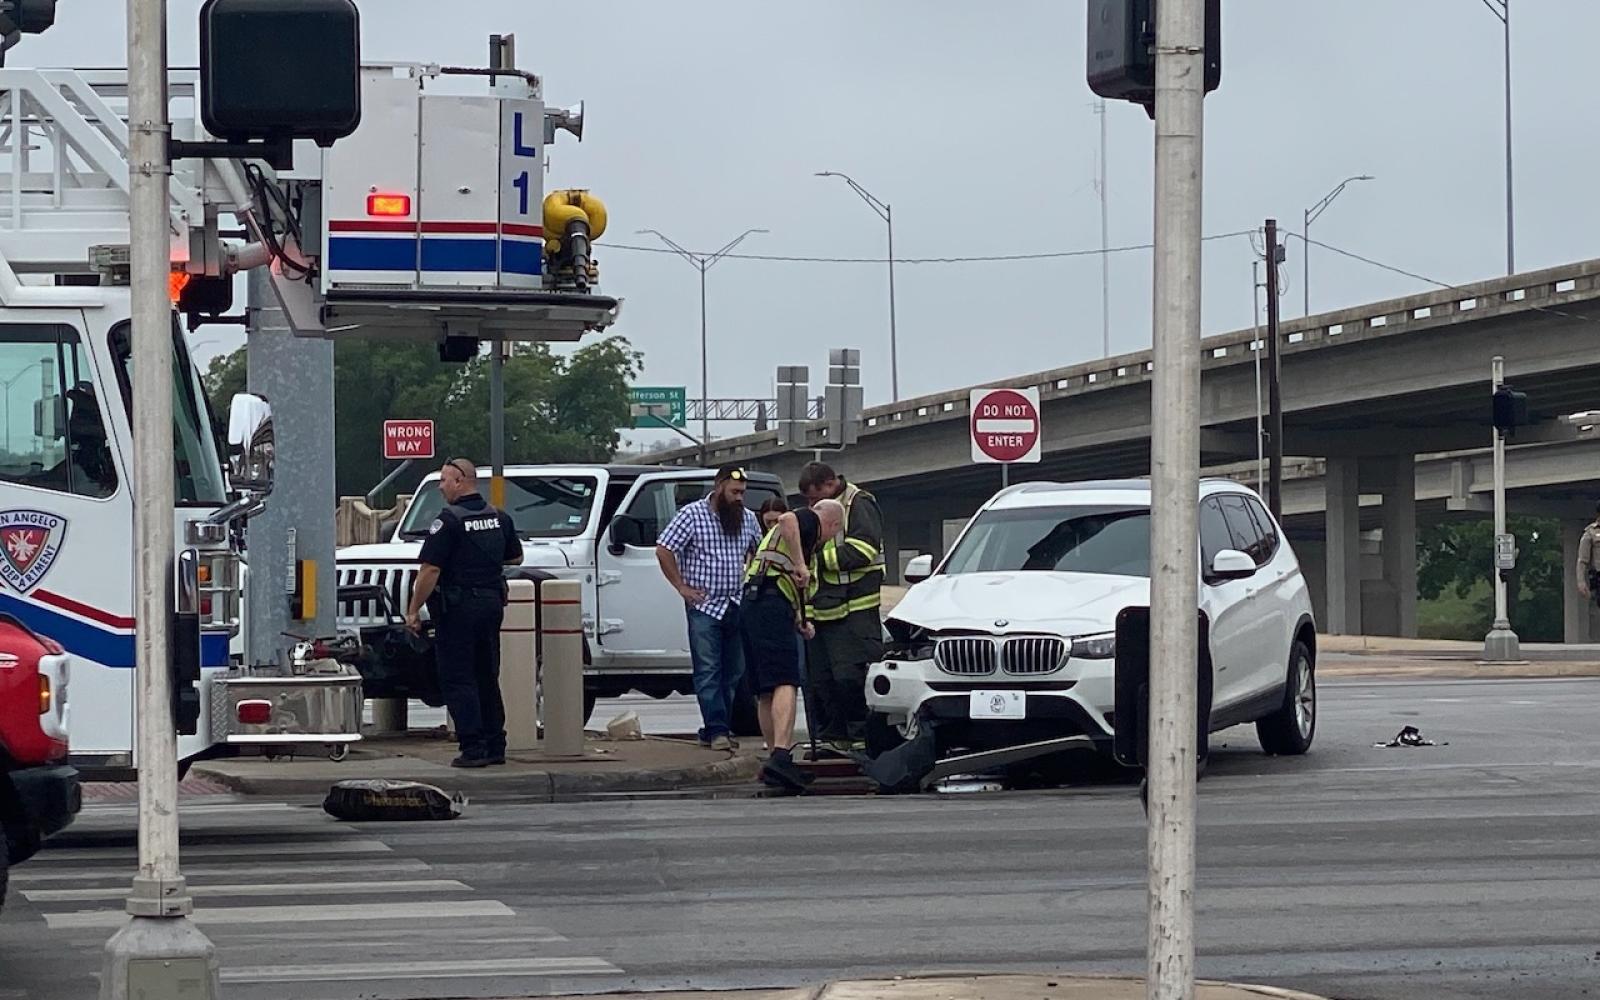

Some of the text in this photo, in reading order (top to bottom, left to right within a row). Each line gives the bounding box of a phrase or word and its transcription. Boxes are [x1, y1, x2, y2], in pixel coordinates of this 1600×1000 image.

[514, 112, 535, 157] L
[513, 171, 528, 214] 1
[983, 405, 1027, 416] DO NOT
[387, 426, 430, 438] WRONG
[397, 440, 421, 452] WAY
[988, 435, 1023, 447] ENTER
[0, 513, 57, 528] N ANGELO
[464, 518, 500, 531] POLICE
[1, 544, 56, 587] DEPARTMENT
